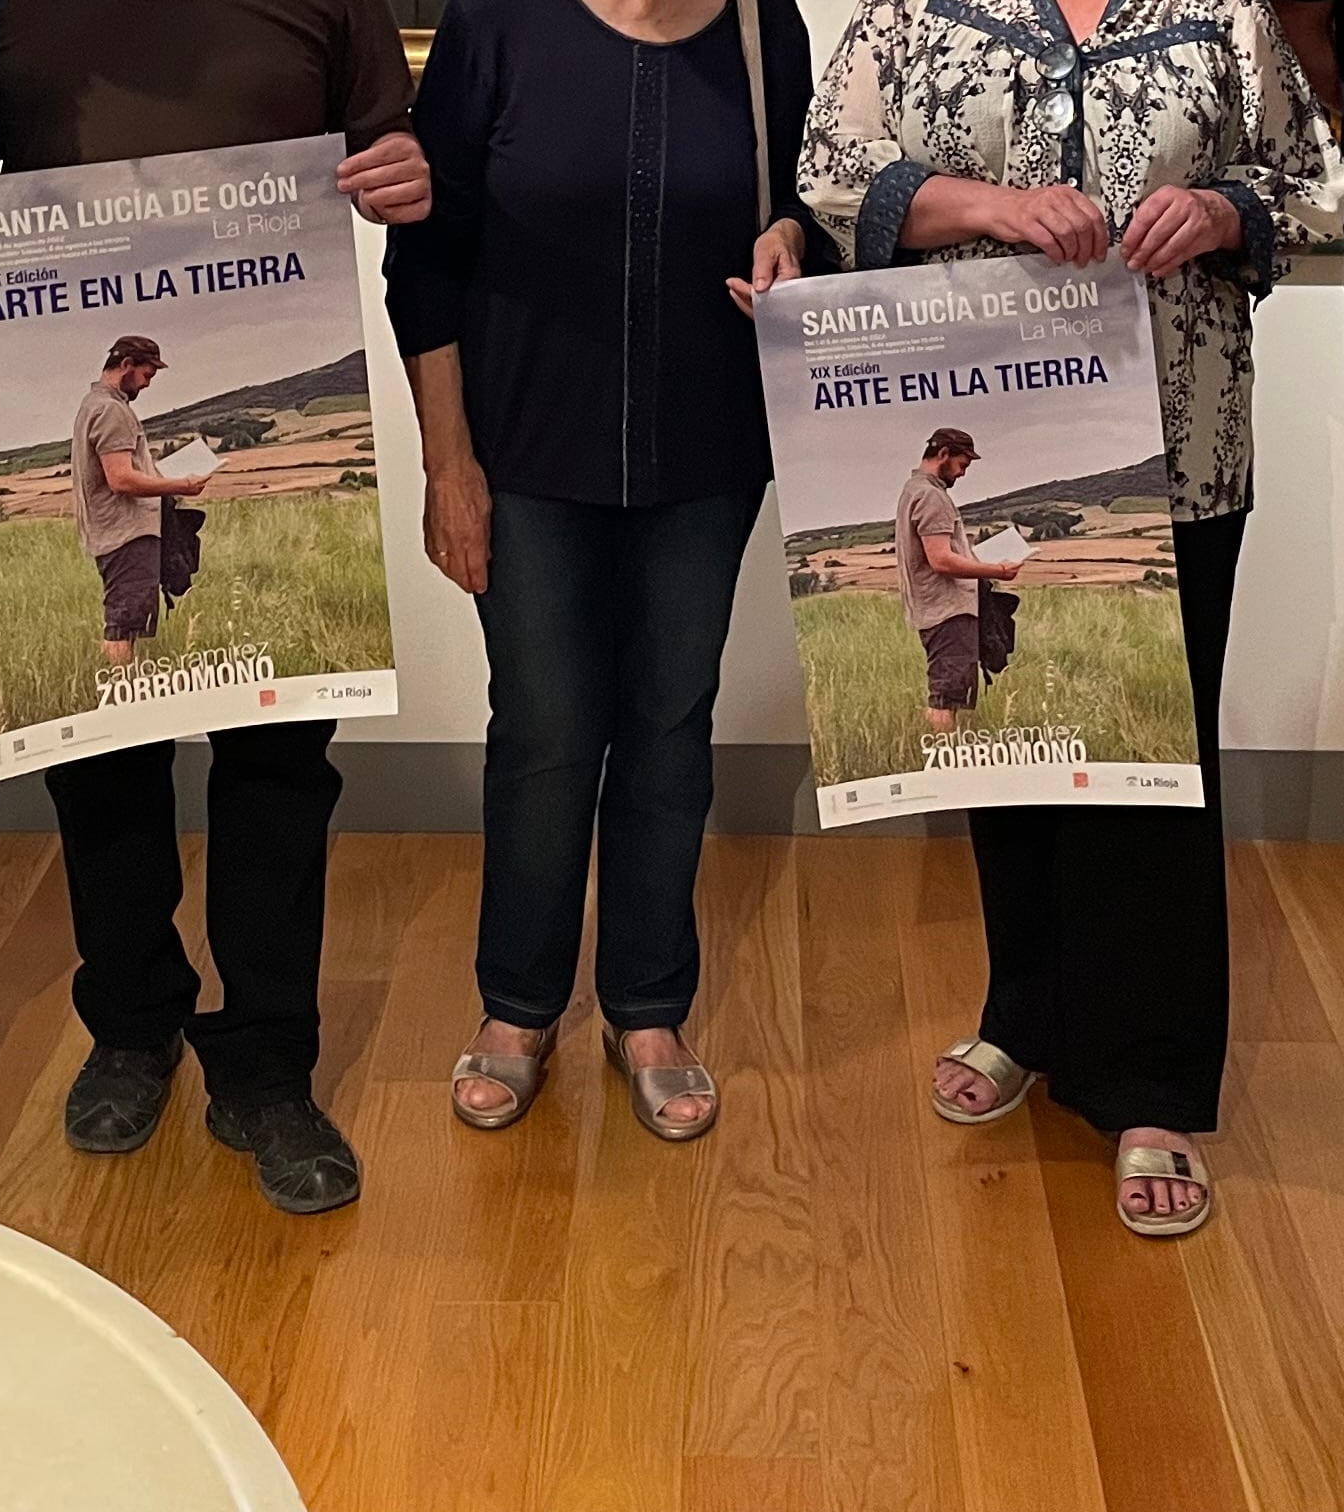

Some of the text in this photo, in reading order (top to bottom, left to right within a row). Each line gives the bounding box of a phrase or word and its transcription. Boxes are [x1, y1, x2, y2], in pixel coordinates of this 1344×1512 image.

[77, 188, 165, 229] LUCÍA
[172, 187, 210, 216] DE
[219, 172, 298, 210] OCÓN
[213, 210, 301, 239] La Rioja
[7, 267, 58, 285] Edición
[80, 275, 124, 309] EN
[135, 269, 178, 302] LA
[184, 252, 306, 294] TIERRA
[802, 278, 1099, 336] SANTA LUCÍA DE OCÓN
[1020, 315, 1103, 341] La Rioja
[810, 363, 880, 380] XIX Edición
[814, 355, 1109, 410] ARTE EN LA TIERRA
[95, 656, 172, 687] carlos
[96, 656, 275, 710] ZORROMONO
[331, 686, 372, 700] La Rioja
[920, 727, 991, 749] carlos
[922, 740, 1087, 773] ZORROMONO
[1141, 778, 1179, 789] La Rioja
